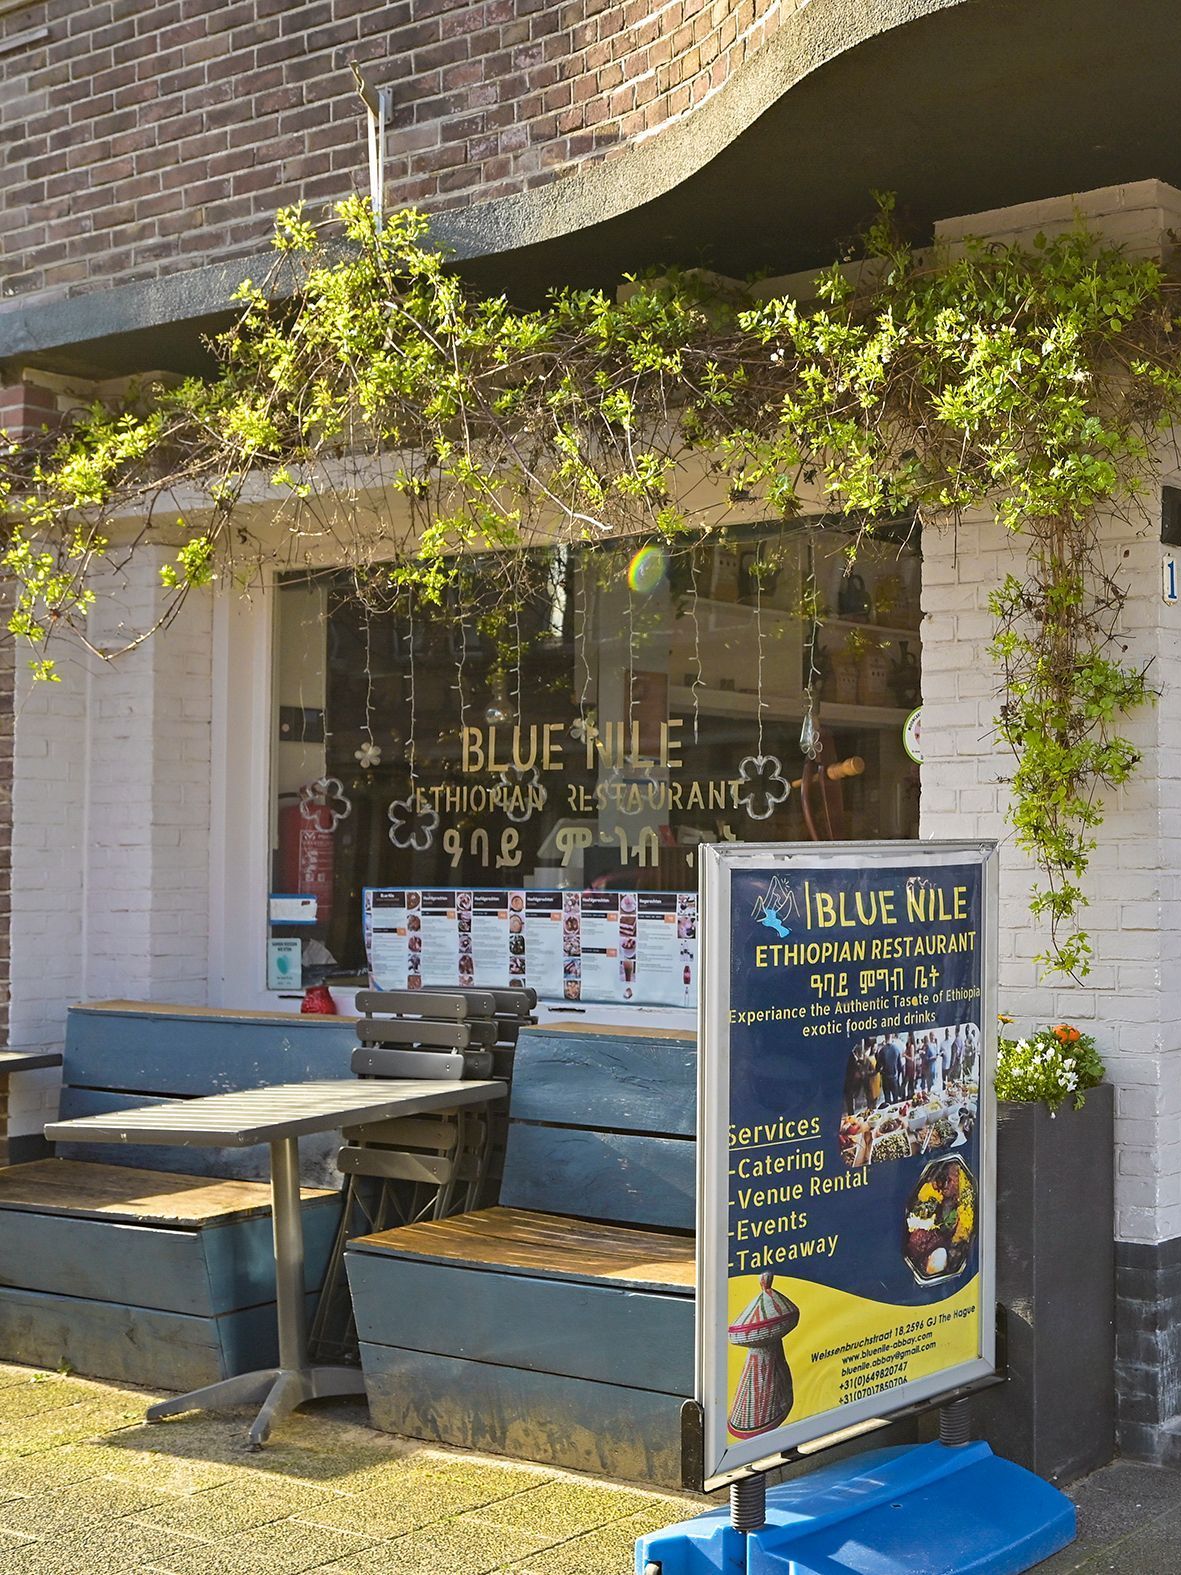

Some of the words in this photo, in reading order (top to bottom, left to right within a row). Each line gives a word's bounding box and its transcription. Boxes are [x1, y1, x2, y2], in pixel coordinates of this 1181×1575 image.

[462, 722, 564, 773] BLUE
[586, 718, 684, 770] NILE
[415, 784, 544, 814] ETHIOPIAN
[567, 780, 745, 811] RESTAURANT
[816, 890, 897, 929] BLUE
[906, 886, 967, 922] NILE
[756, 940, 866, 968] ETHIOPIAN
[871, 931, 976, 960] RESTAURANT
[810, 972, 848, 998] ዓባይ
[859, 967, 904, 995] ምግብ
[728, 1006, 806, 1026] Experiance
[810, 1003, 831, 1017] the
[834, 998, 890, 1015] Authentic
[932, 990, 944, 1004] of
[946, 985, 981, 1002] Ethiopia
[802, 1023, 842, 1037] exotic
[846, 1016, 877, 1036] foods
[880, 1012, 901, 1028] and
[903, 1010, 936, 1026] drinks
[728, 1116, 820, 1146] Services
[728, 1148, 825, 1179] -Catering
[810, 1166, 869, 1197] Rental
[811, 1330, 893, 1363] Weissenbruchstraat
[926, 1316, 937, 1327] GJ
[938, 1312, 952, 1324] The
[953, 1305, 976, 1319] Hague
[839, 1361, 908, 1390] +31(0)649820747
